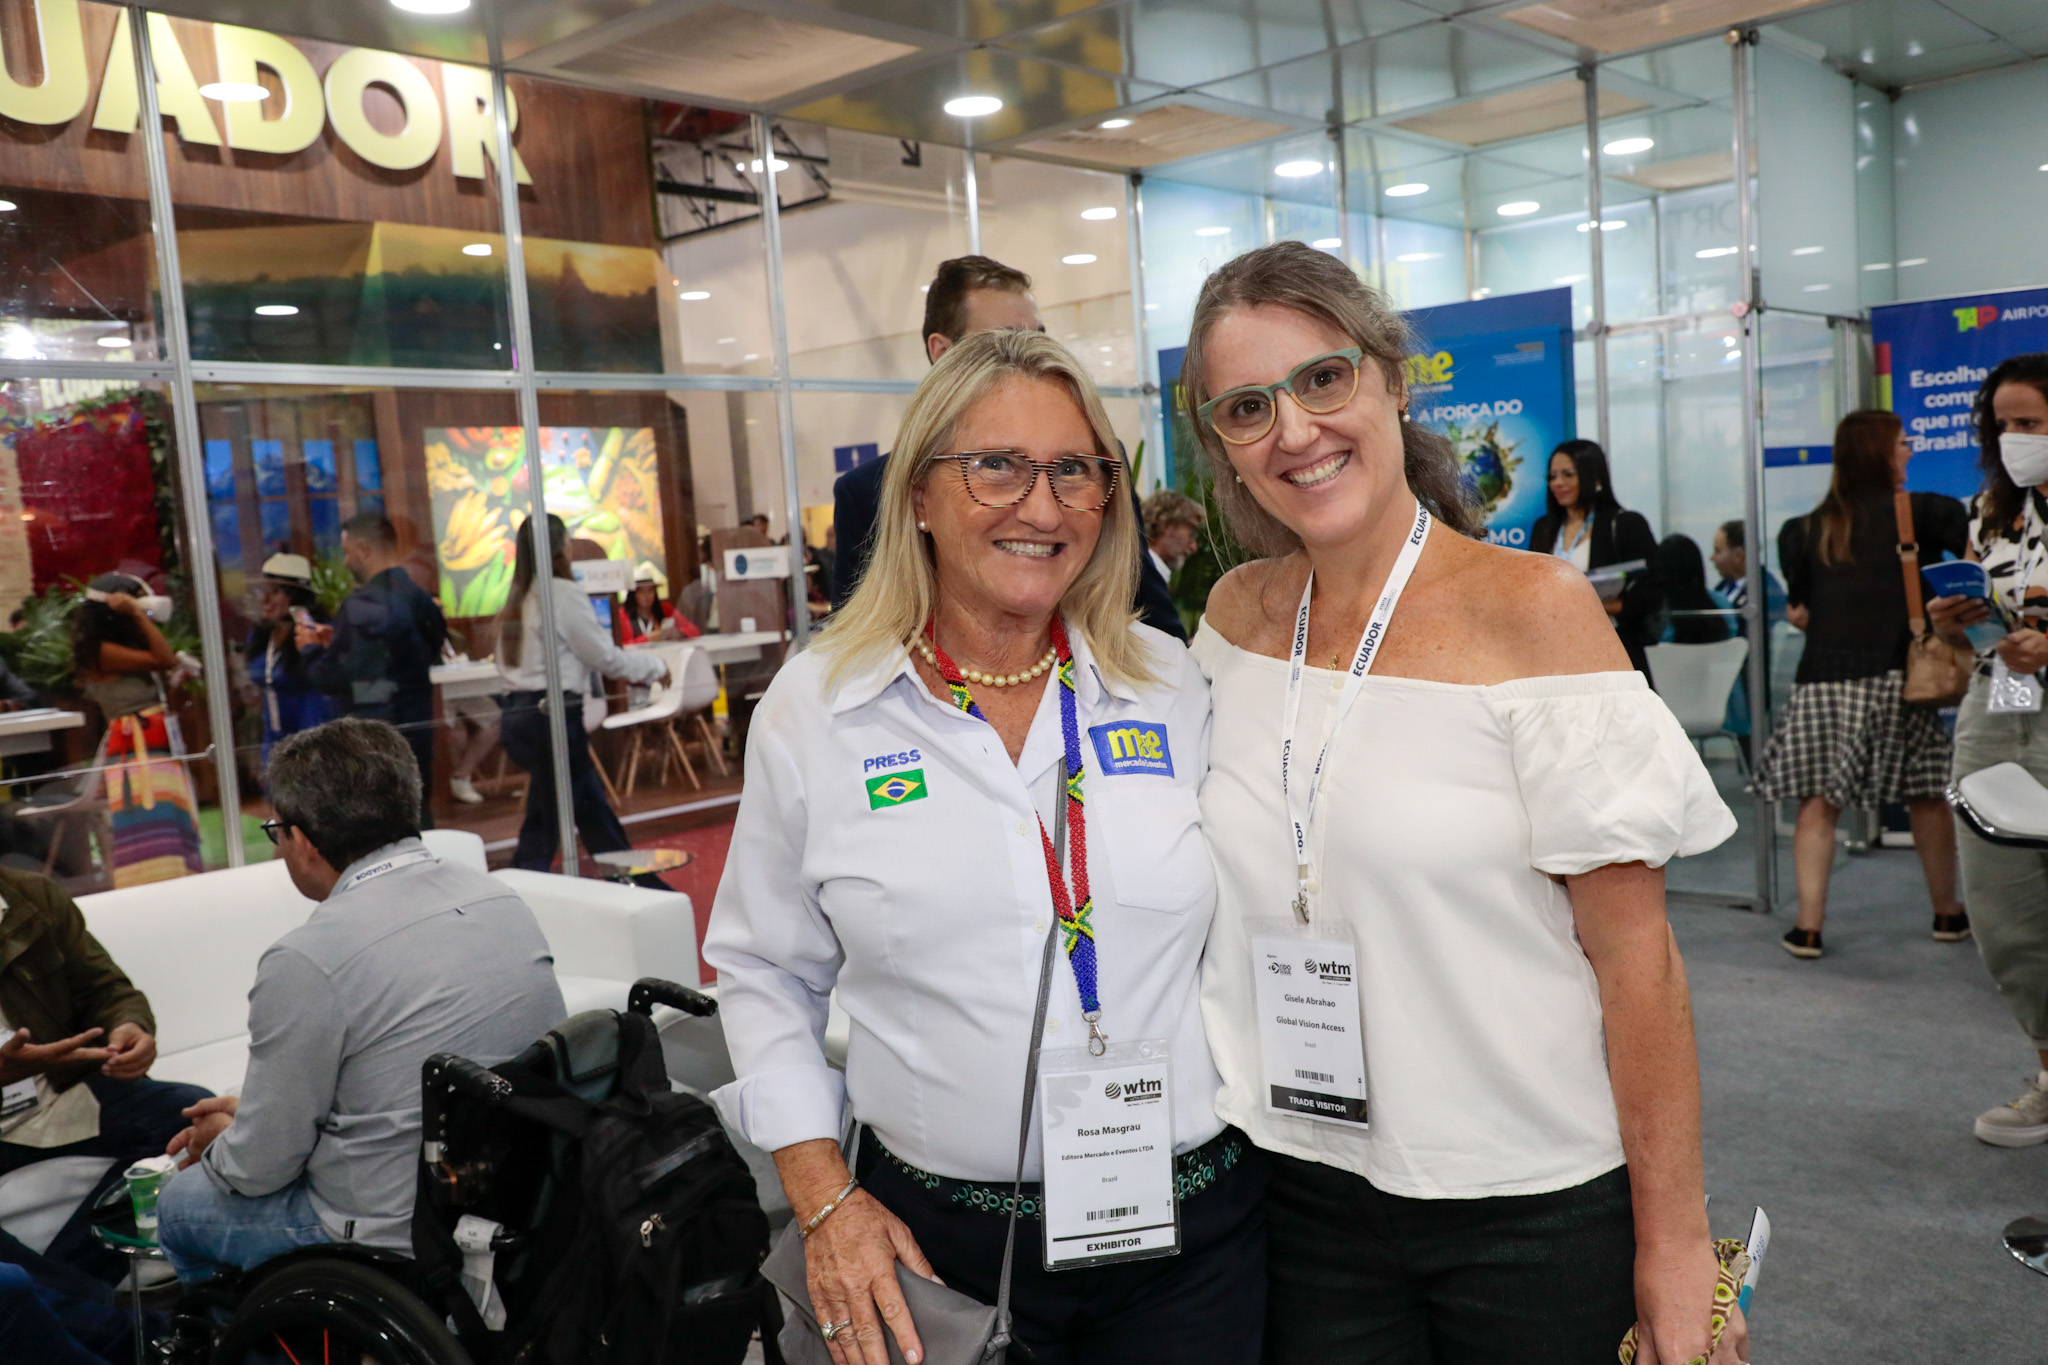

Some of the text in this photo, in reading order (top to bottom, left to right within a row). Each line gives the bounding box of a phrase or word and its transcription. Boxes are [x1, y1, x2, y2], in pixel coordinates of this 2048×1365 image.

[1953, 306, 1998, 332] TAP
[1910, 366, 1988, 388] Escolha
[1924, 389, 1986, 408] comp
[1433, 402, 1492, 424] FORÇA
[1494, 399, 1523, 416] DO
[1911, 414, 1950, 434] que
[1913, 431, 1968, 452] Brasil
[1294, 606, 1307, 657] ECUADOR
[1353, 622, 1382, 677] ECUADOR
[864, 749, 921, 773] PRESS
[1319, 960, 1351, 976] wtm
[1284, 994, 1336, 1007] Gisele Abrahao
[1276, 1016, 1345, 1032] Global Vision Access
[1124, 1078, 1161, 1095] wtm
[1288, 1096, 1347, 1113] TRADE VISITOR
[1077, 1123, 1141, 1137] Rosa Masgrau
[1084, 1150, 1110, 1159] Mercado
[1115, 1147, 1138, 1155] Eventos
[1138, 1145, 1154, 1153] LTDA
[1101, 1175, 1118, 1183] Brazil
[1086, 1237, 1142, 1252] EXHIBITOR
